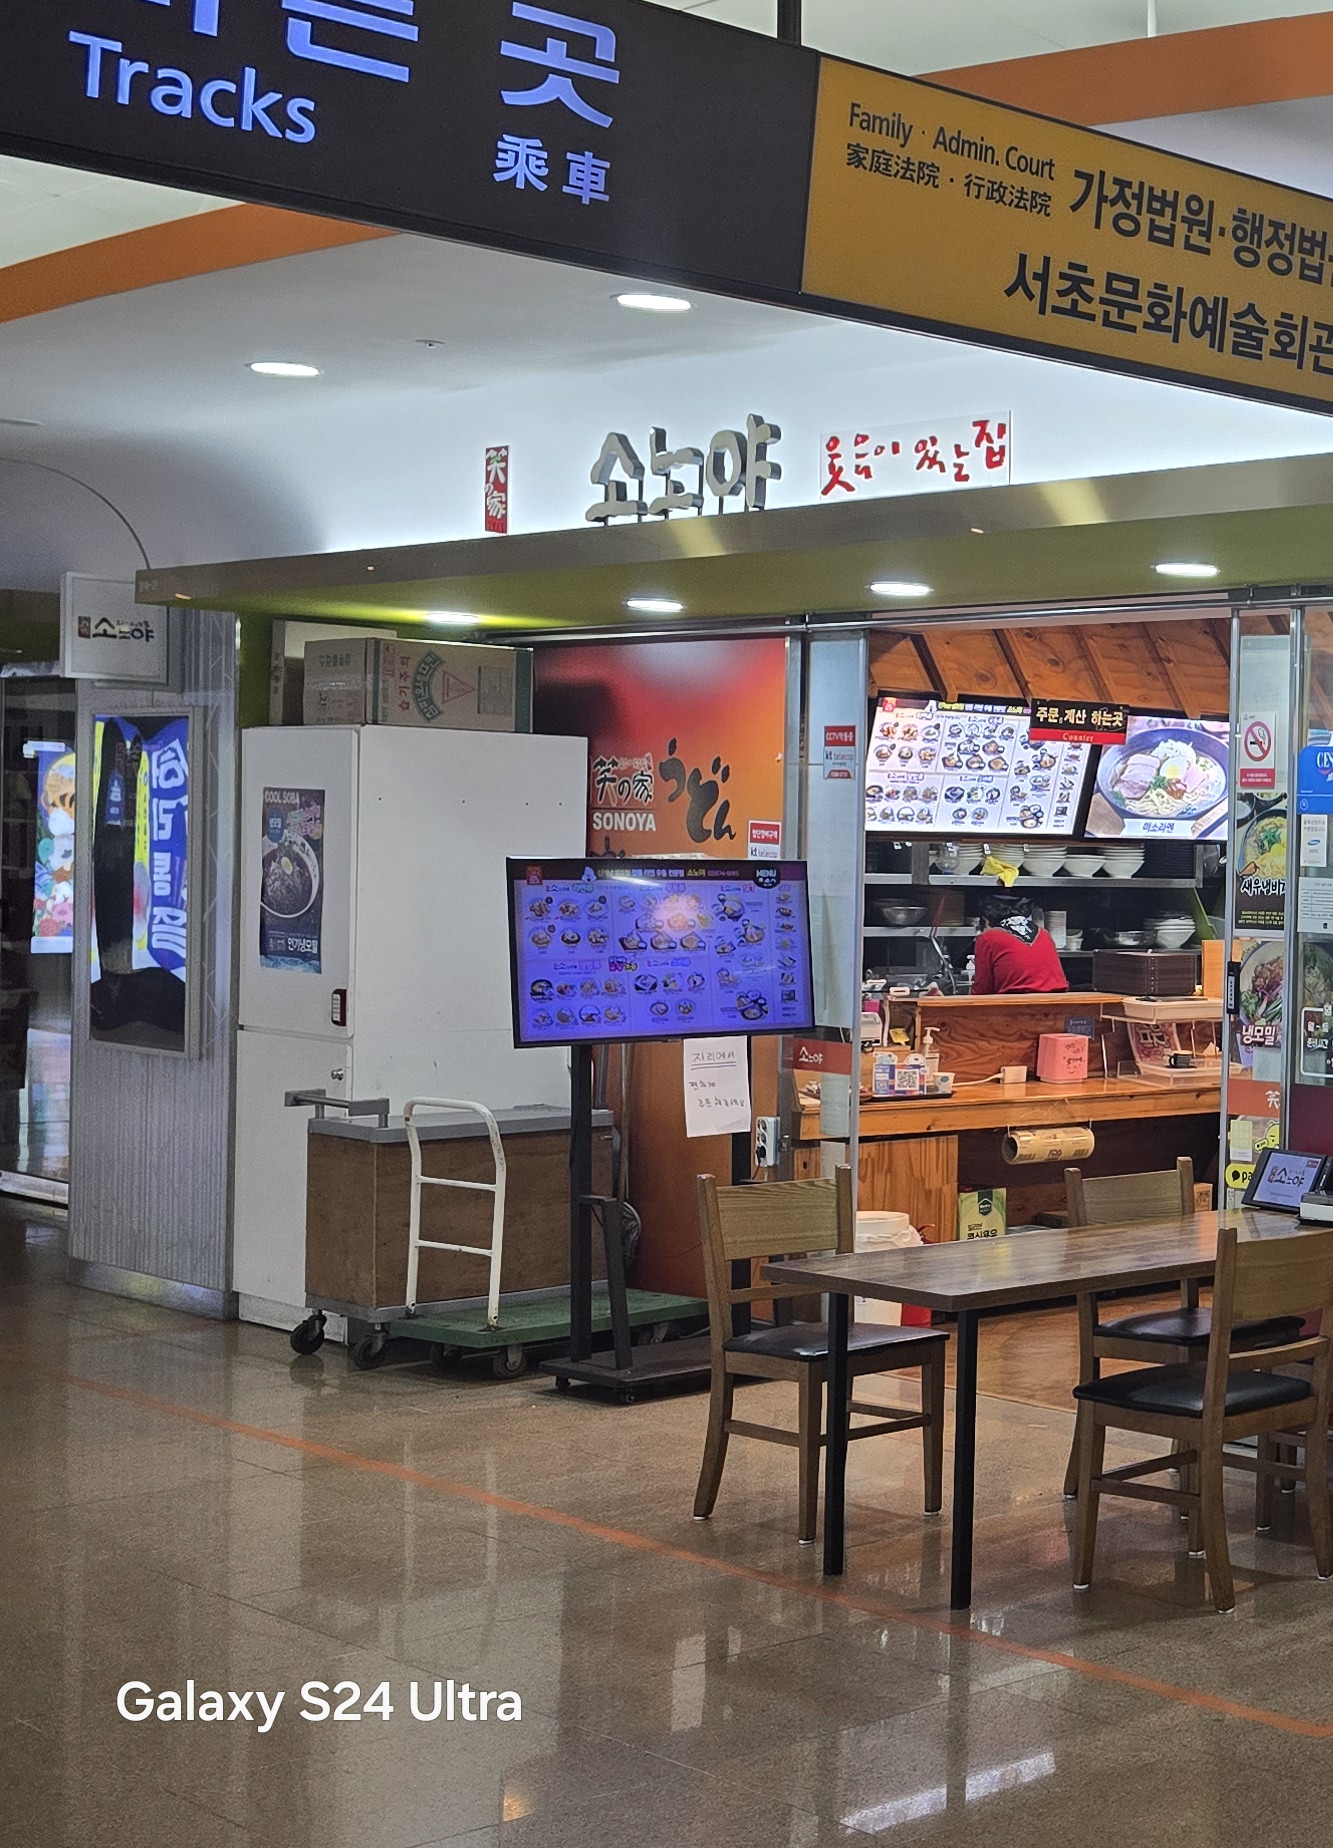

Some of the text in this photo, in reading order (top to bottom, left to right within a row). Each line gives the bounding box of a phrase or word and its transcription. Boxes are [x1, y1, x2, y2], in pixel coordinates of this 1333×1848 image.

[68, 30, 316, 143] Tracks
[500, 1, 620, 128] 곳
[493, 134, 611, 204] 乘車
[849, 102, 1055, 181] Family Admin. Court
[586, 414, 782, 524] 소노야
[821, 435, 900, 497] 웃음이
[1063, 731, 1095, 742] Counter
[592, 811, 657, 831] SONOYA
[659, 738, 736, 843] うどん
[1243, 1025, 1277, 1045] 냉모밀
[1241, 1171, 1252, 1183] pa
